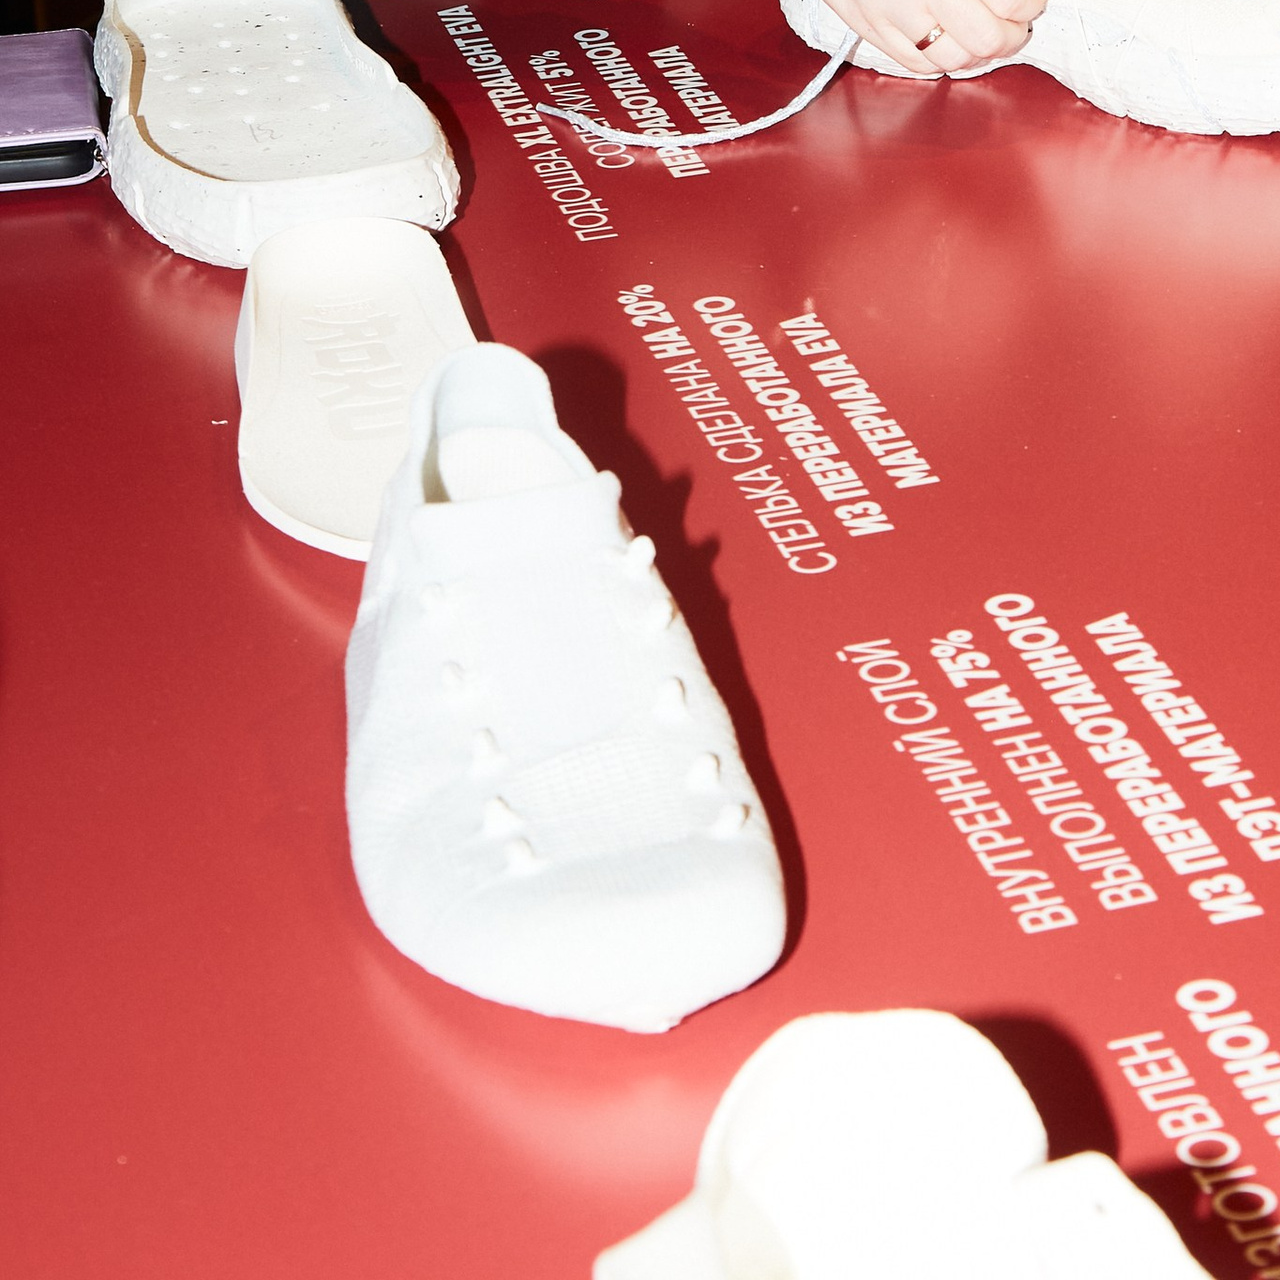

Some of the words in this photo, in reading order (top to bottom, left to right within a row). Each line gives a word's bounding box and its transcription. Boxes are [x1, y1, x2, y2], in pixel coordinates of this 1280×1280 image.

[437, 5, 483, 35] EVA
[454, 38, 545, 126] EXTRALIGHT
[529, 51, 573, 79] 51%
[573, 28, 711, 179] ПЕРРАБОТАННОГО
[513, 125, 559, 151] XL
[528, 148, 618, 241] ПОДОШВА
[617, 285, 675, 327] 20%
[642, 326, 696, 359] НА
[780, 312, 831, 355] EVA
[663, 359, 763, 463] СДЕЛАНА
[693, 296, 869, 501] ПЕРЕРАБОТАННОГО
[809, 354, 940, 489] МАТЕРИАЛА
[733, 464, 837, 574] СТЕЛЬКА
[834, 501, 894, 536] ИЗ
[836, 639, 938, 725] СЛОЙ
[931, 629, 1000, 688] 75%
[964, 684, 1032, 732] НА
[984, 593, 1228, 875] ПЕРЕРАБОТАННОГО
[893, 727, 1078, 934] ВНУТРЕННИЙ
[993, 732, 1157, 910] ВЫПОЛНЕН
[1188, 874, 1264, 925] ИЗ
